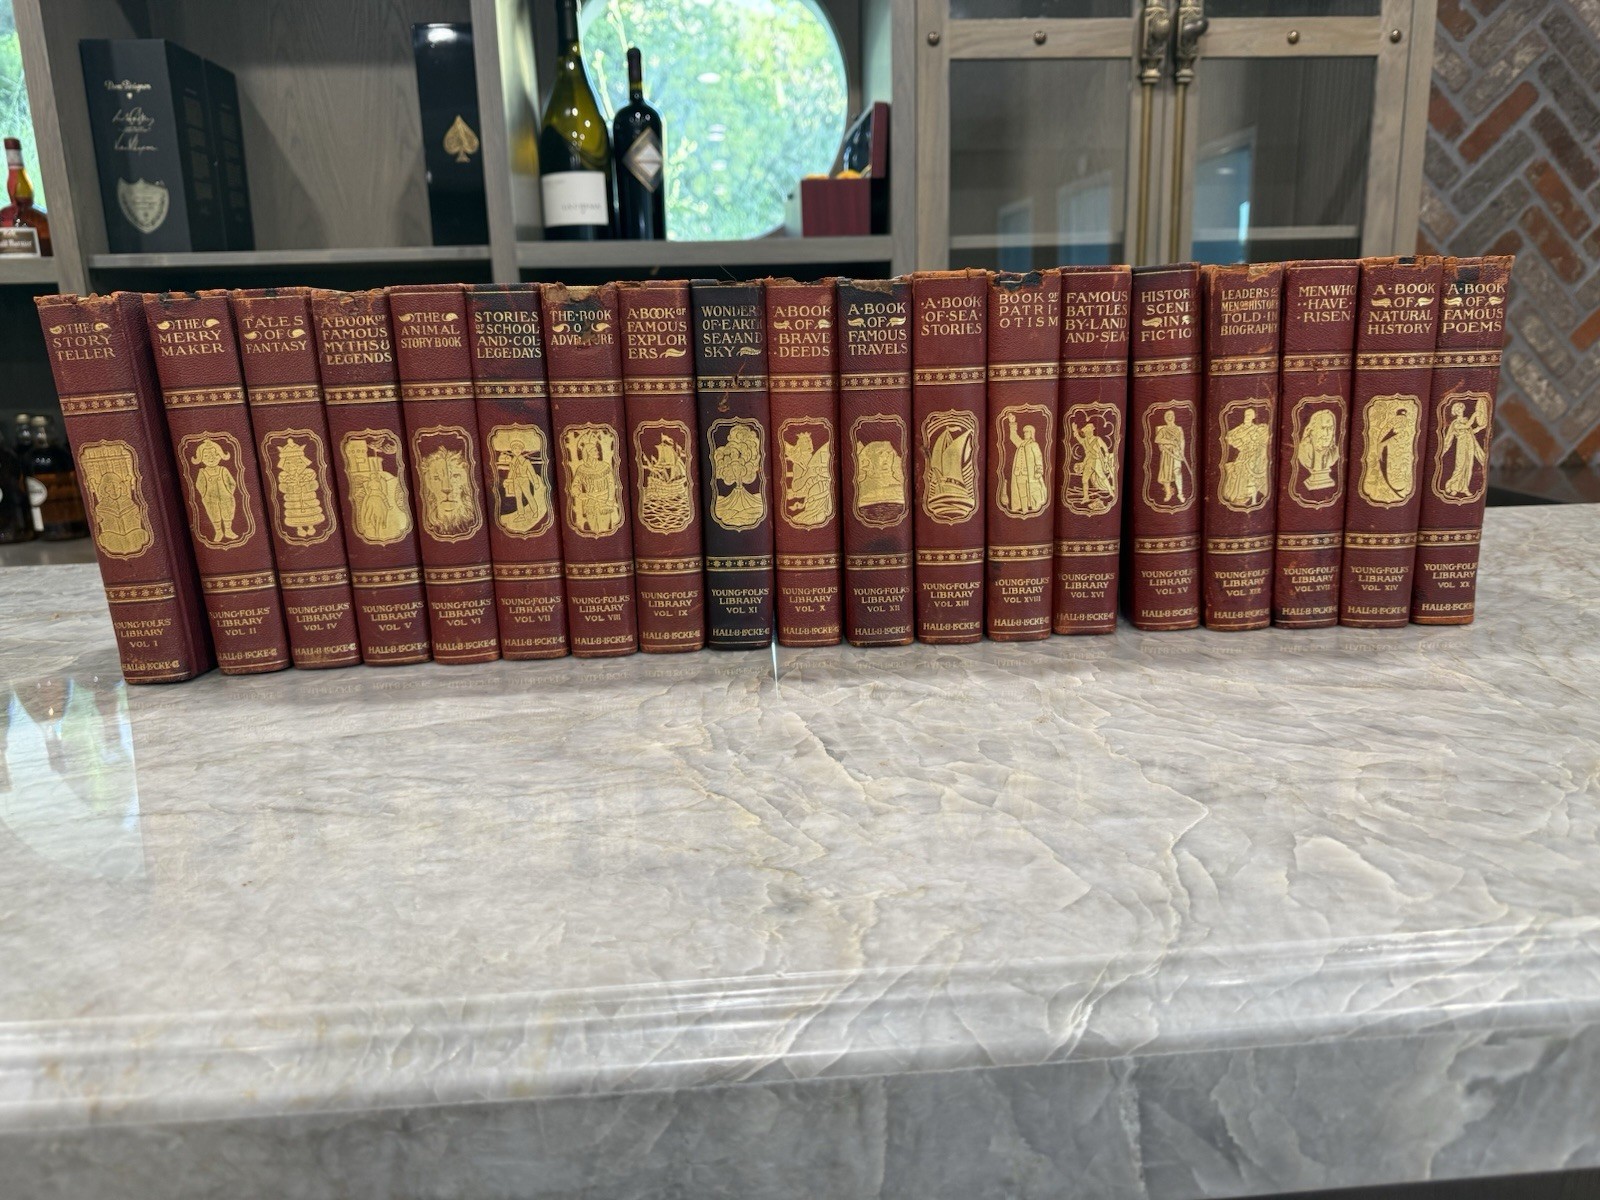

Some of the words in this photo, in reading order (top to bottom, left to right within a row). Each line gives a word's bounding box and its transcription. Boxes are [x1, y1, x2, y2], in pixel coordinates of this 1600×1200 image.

[999, 292, 1045, 304] BOOK
[1066, 291, 1128, 304] FAMOUS
[1221, 288, 1270, 300] LEADERS
[1307, 298, 1349, 310] HAVE
[1394, 297, 1416, 308] OF
[1465, 296, 1485, 307] OF
[1066, 304, 1128, 317] BATTLES
[1368, 309, 1434, 323] NATURAL
[1443, 308, 1504, 321] FAMOUS
[242, 315, 304, 329] TALES
[415, 312, 440, 323] THE
[474, 311, 539, 323] STORIES
[867, 316, 888, 328] OF
[999, 316, 1059, 329] OTISM
[1304, 311, 1351, 323] RISEN
[66, 322, 92, 334] THE
[175, 318, 201, 330] THE
[401, 324, 461, 336] ANIMAL
[485, 323, 540, 335] SCHOOL
[627, 321, 687, 333] FAMOUS
[795, 319, 815, 330] OF
[920, 323, 982, 336] STORIES
[1220, 323, 1278, 336] BIOGRAPHY
[1368, 323, 1433, 335] HISTORY
[1442, 321, 1502, 334] POEMS
[159, 330, 222, 344] MERRY
[264, 329, 284, 340] OF
[322, 327, 388, 341] FAMOUS
[550, 334, 615, 346] ADVEURE
[628, 334, 687, 346] EXPLOR
[778, 332, 832, 344] BRAVE
[849, 329, 908, 343] FAMOUS
[1141, 327, 1195, 342] FICTIO
[52, 334, 112, 348] STORY
[245, 340, 307, 354] FANTASY
[324, 340, 379, 353] MYTHS
[401, 337, 433, 349] STORY
[436, 336, 462, 348] BOOK
[56, 347, 116, 361] TELLER
[161, 343, 225, 357] MAKER
[628, 348, 658, 359] ERS
[704, 346, 735, 358] SKY
[778, 346, 831, 358] DEEDS
[849, 343, 909, 356] TRAVELS
[326, 352, 393, 366] LEGENDS
[1291, 574, 1334, 584] LIBRARY
[1358, 574, 1404, 583] LIBRARY
[1432, 571, 1476, 580] LIBRARY
[1065, 581, 1110, 590] LIBRARY
[1149, 577, 1193, 587] LIBRARY
[1222, 577, 1266, 588] LIBRARY
[930, 590, 975, 599] LIBRARY
[1001, 586, 1044, 595] LIBRARY
[648, 599, 693, 608] LIBRARY
[719, 597, 763, 605] LIBRARY
[789, 595, 832, 603] LIBRARY
[861, 594, 905, 604] LIBRARY
[438, 608, 485, 619] LIBRARY
[509, 604, 555, 614] LIBRARY
[579, 603, 625, 613] LIBRARY
[217, 617, 264, 628] LIBRARY
[296, 611, 344, 623] LIBRARY
[371, 611, 418, 622] LIBRARY
[120, 628, 164, 638] LIBRARY
